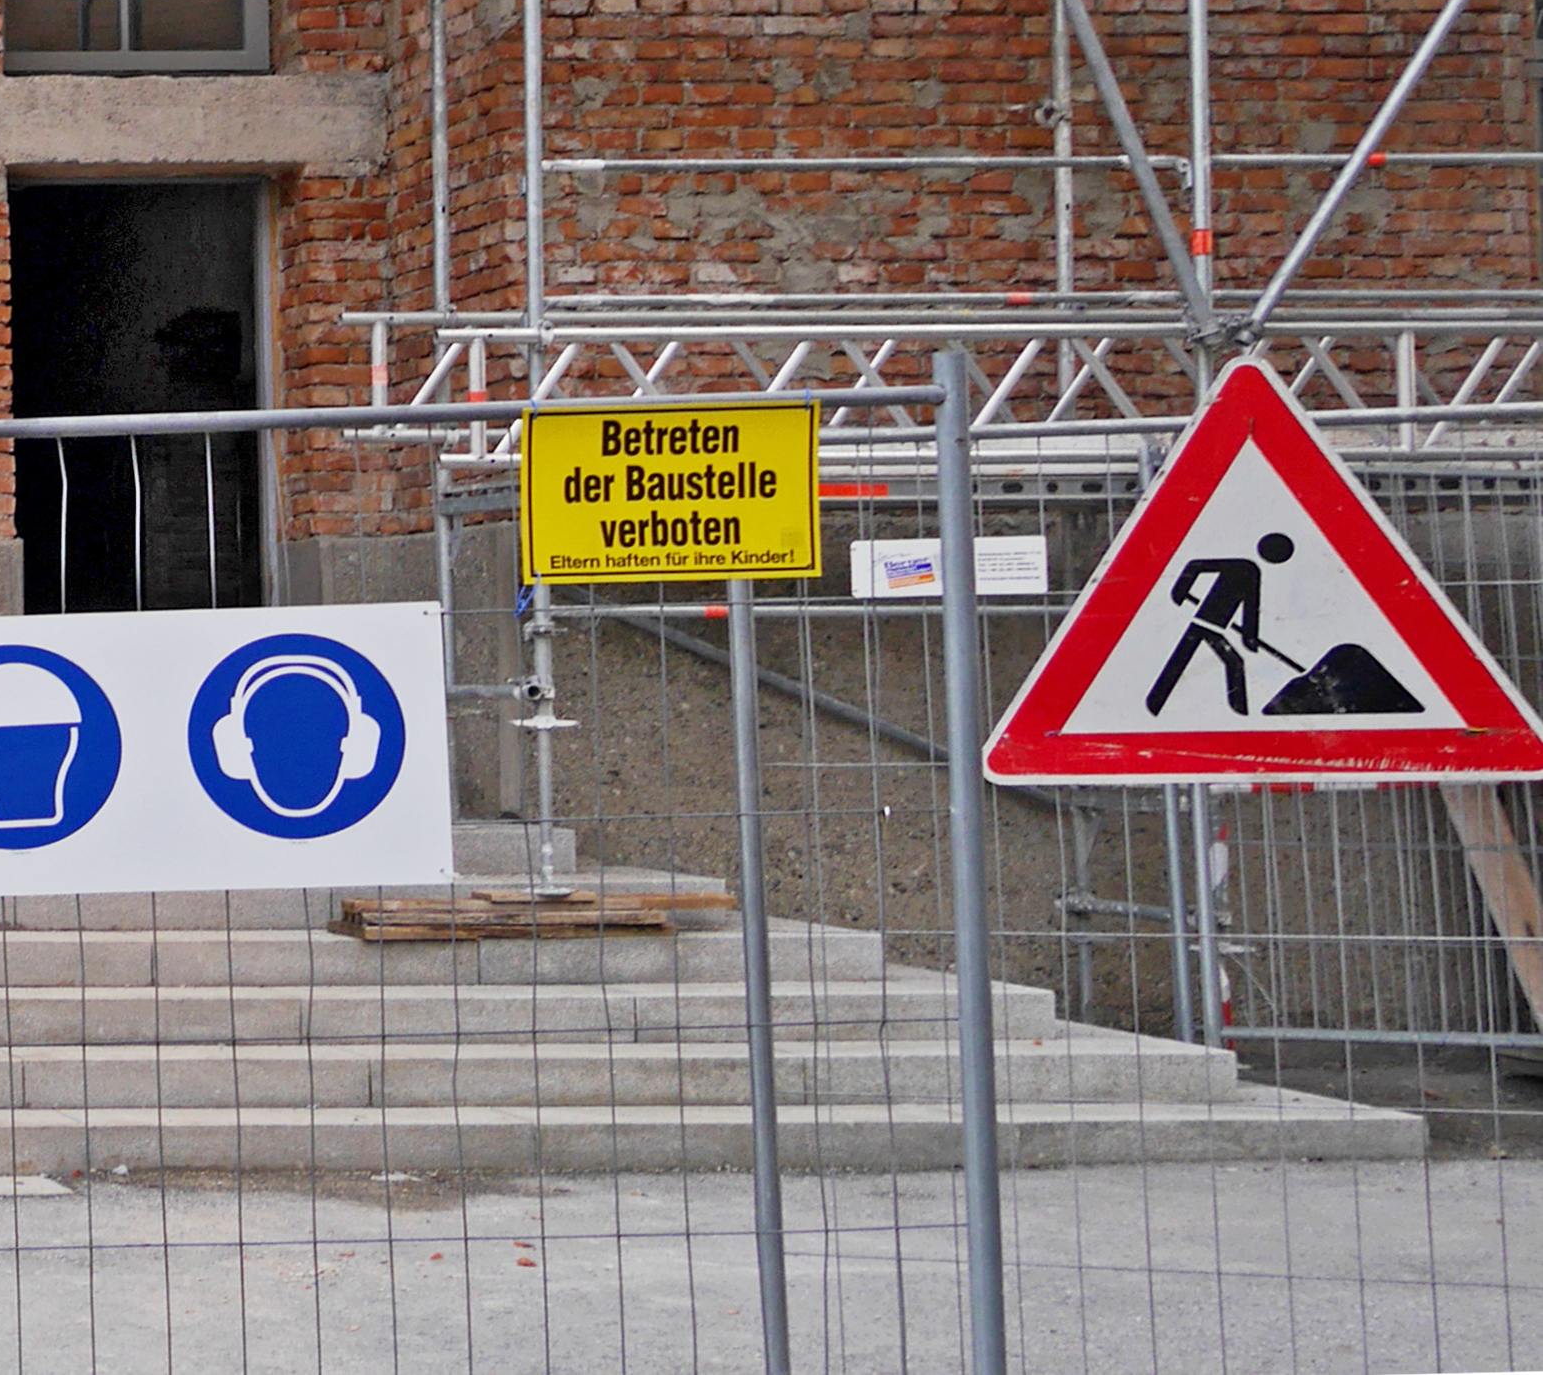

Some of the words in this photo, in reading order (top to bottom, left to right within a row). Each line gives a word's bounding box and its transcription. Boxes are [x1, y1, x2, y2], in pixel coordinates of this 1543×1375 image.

[601, 418, 739, 457] Betreten
[563, 466, 615, 504] der
[625, 461, 777, 502] Baustelle
[600, 510, 741, 548] verboten
[550, 554, 600, 569] Eltern
[605, 553, 660, 568] haften
[664, 552, 689, 566] für
[693, 551, 726, 566] ihre
[731, 549, 795, 565] Kinder!
